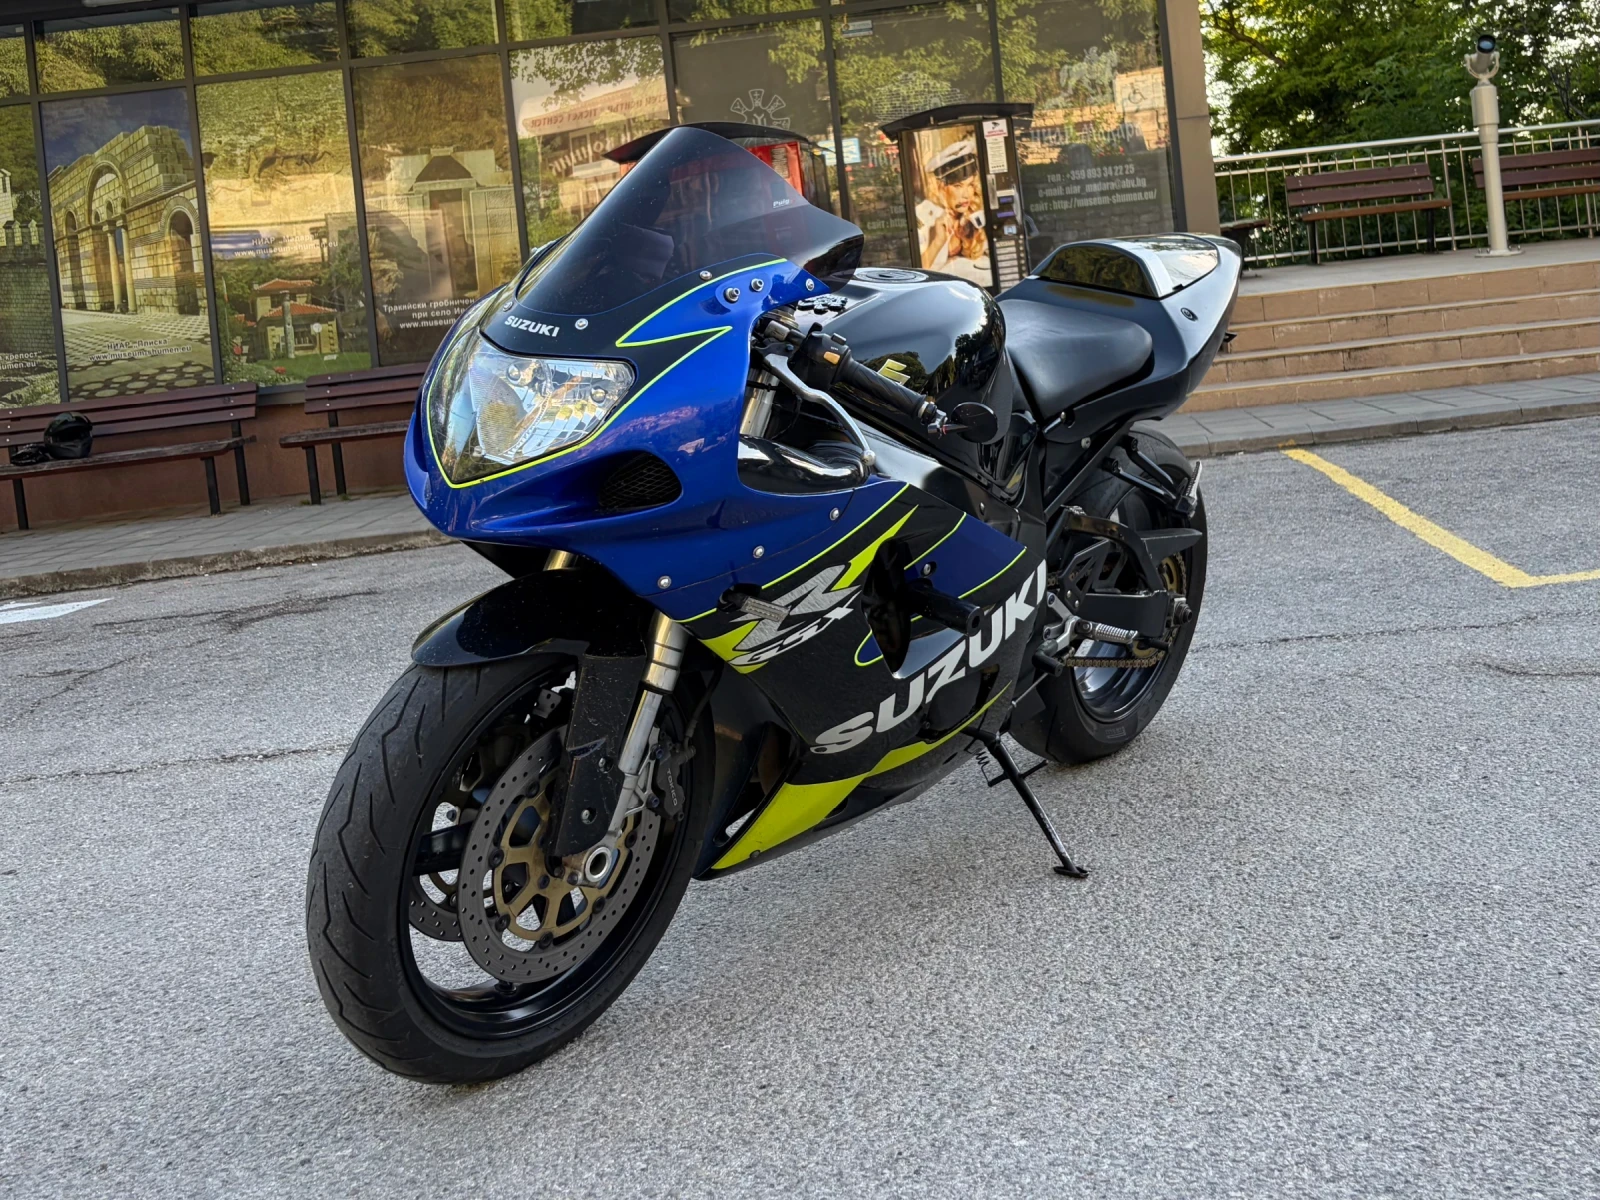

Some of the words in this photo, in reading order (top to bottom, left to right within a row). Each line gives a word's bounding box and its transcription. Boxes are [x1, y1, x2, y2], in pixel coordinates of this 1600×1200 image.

[1086, 167, 1101, 179] 893
[1102, 166, 1113, 177] 34
[1113, 164, 1124, 176] 22
[1124, 163, 1135, 175] 25
[412, 311, 428, 320] при
[431, 309, 451, 318] село
[504, 315, 560, 337] SUZUKI
[809, 558, 1047, 755] SUZUKI
[666, 767, 678, 806] TOKICO
